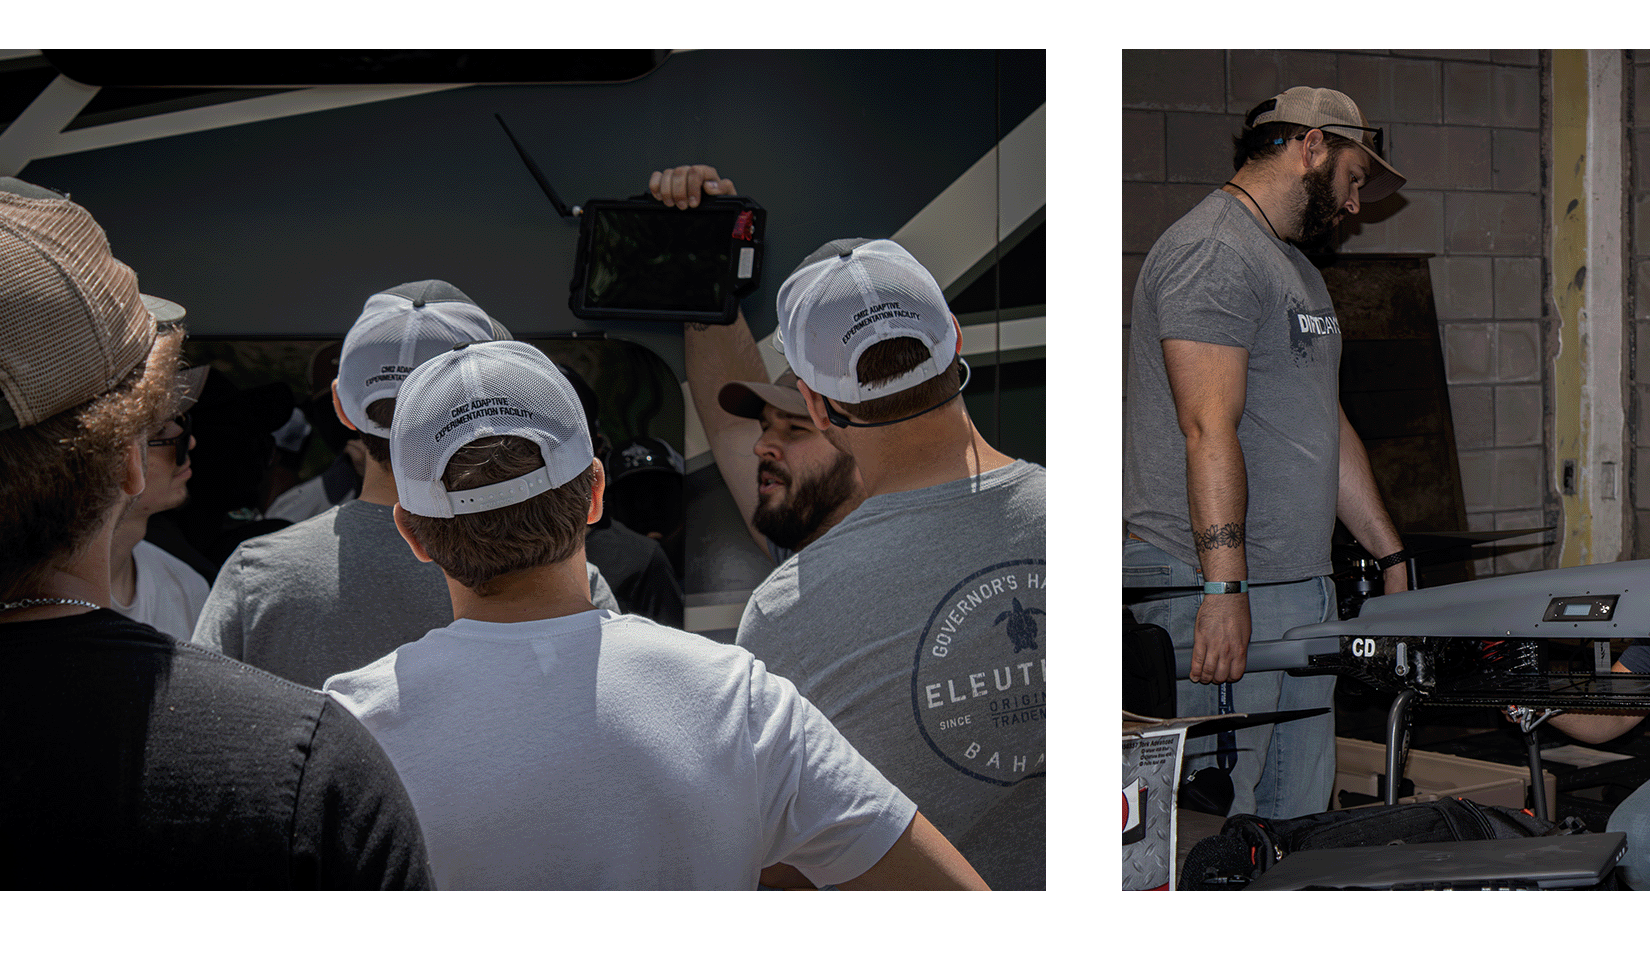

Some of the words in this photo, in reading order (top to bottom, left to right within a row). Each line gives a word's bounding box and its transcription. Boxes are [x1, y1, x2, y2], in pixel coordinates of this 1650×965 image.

[869, 302, 900, 314] ADAPTIVE
[842, 311, 893, 344] EXPERIMENTATION
[893, 310, 920, 320] FACILITY
[471, 397, 509, 410] ADAPTIVE
[434, 407, 499, 443] EXPERIMENTATION
[499, 406, 534, 419] FACILITY
[932, 574, 1019, 658] GOVERNOR'S
[1352, 638, 1376, 657] CD
[939, 714, 972, 731] SINCE
